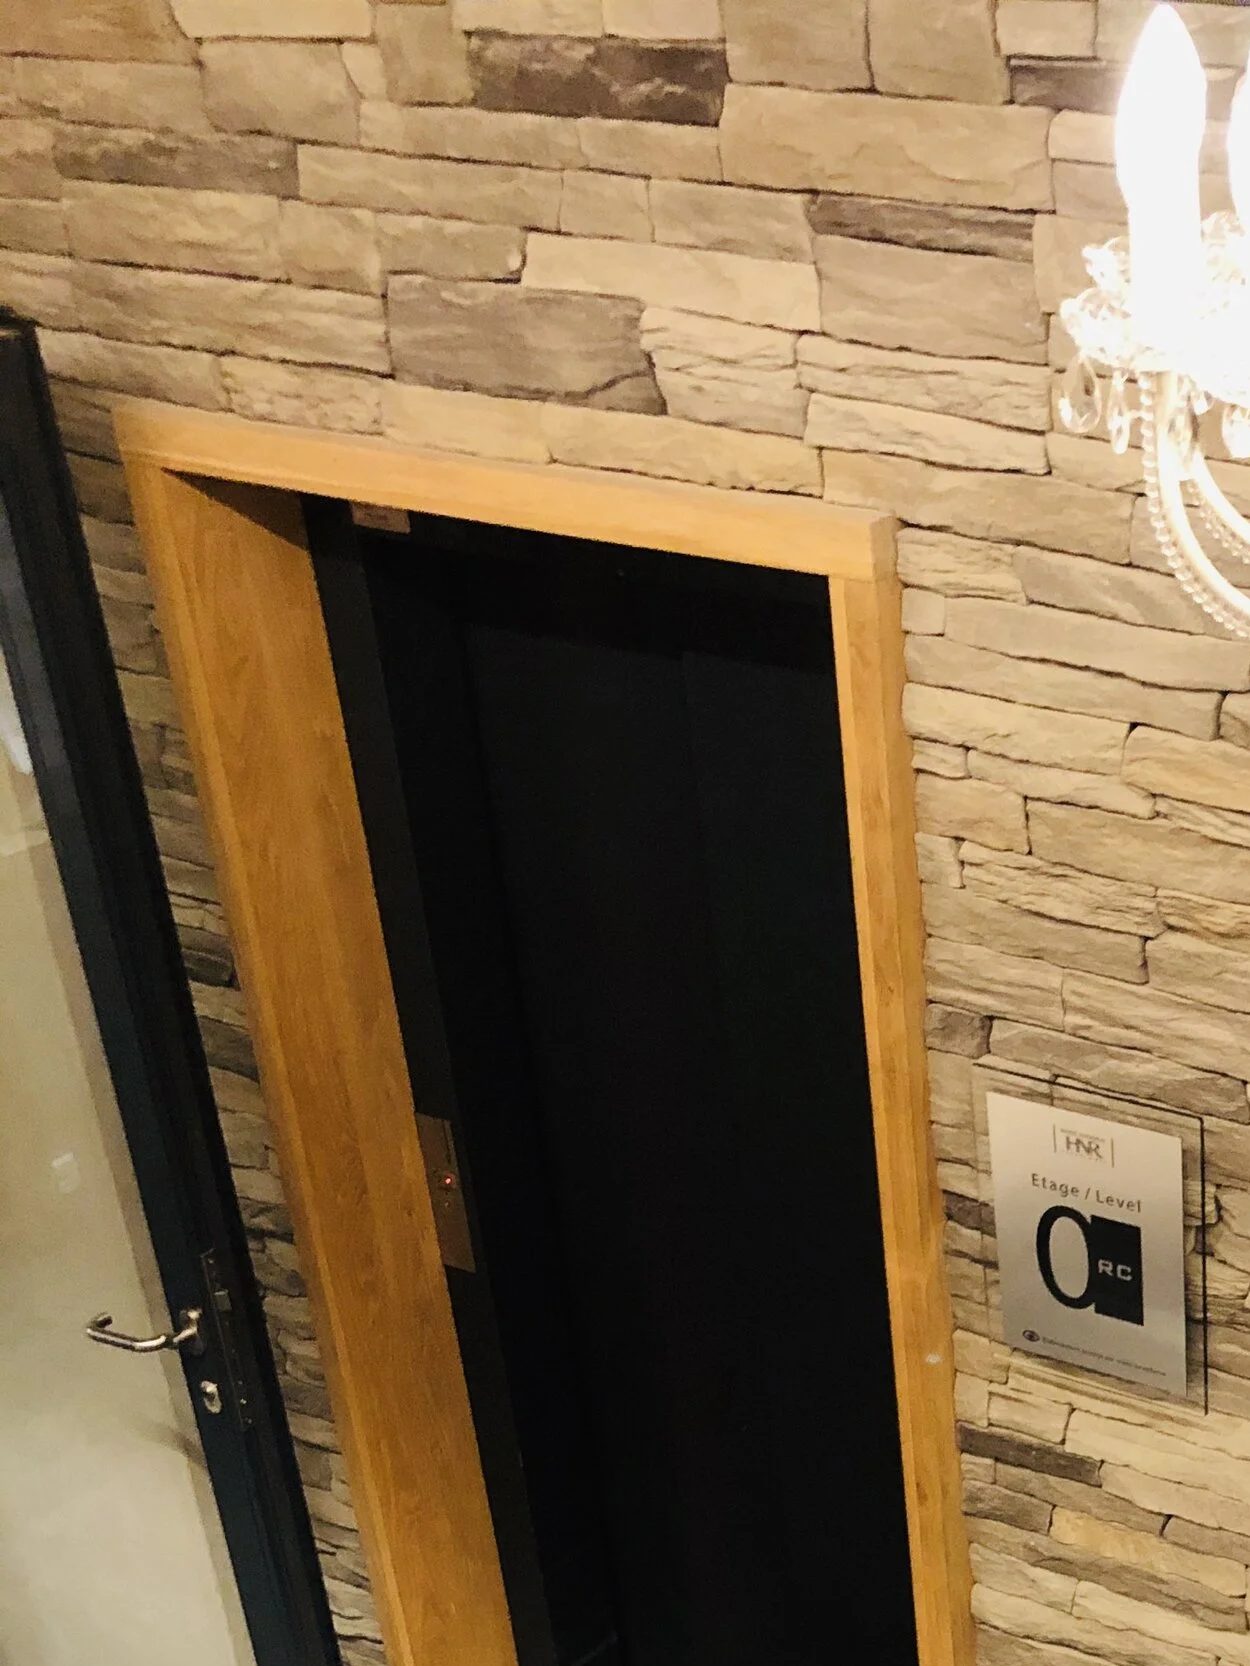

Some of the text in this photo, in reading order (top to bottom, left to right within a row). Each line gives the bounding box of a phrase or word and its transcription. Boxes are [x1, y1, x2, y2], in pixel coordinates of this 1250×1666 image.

[1031, 1174, 1079, 1197] Etage
[1096, 1193, 1141, 1213] Level
[1098, 1259, 1132, 1280] RC
